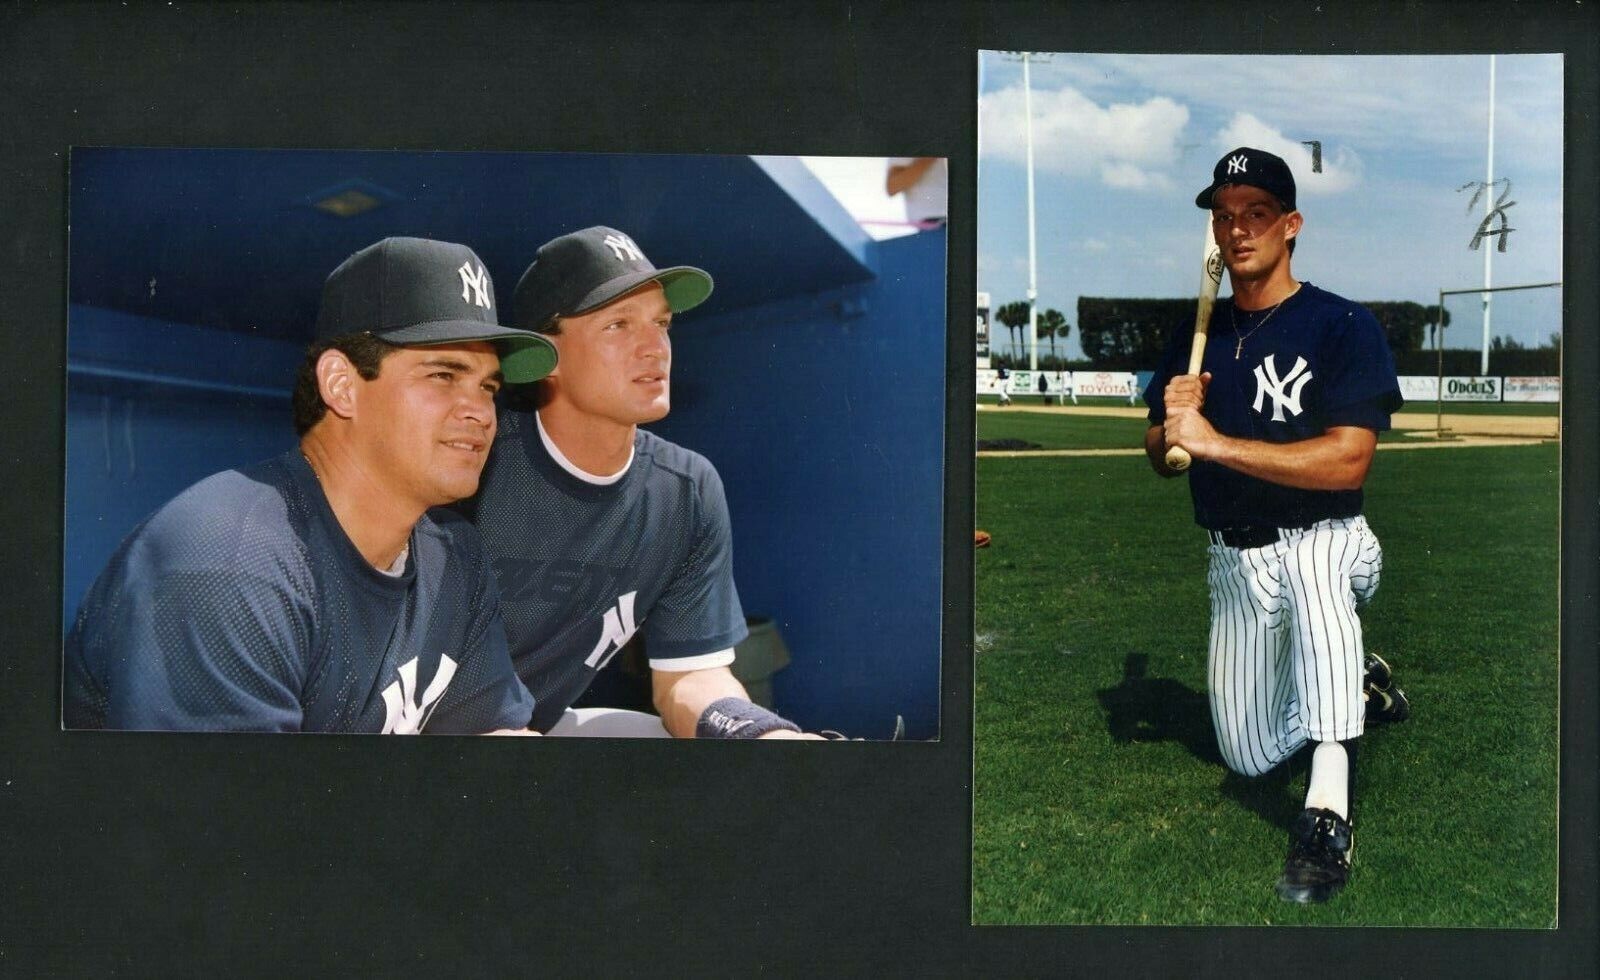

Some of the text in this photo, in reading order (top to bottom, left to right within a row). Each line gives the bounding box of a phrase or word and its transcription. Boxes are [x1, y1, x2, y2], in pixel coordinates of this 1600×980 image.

[1227, 154, 1249, 176] NY
[603, 234, 644, 262] NY
[457, 260, 491, 310] NY
[1080, 384, 1127, 394] TOYOTA
[1252, 353, 1313, 423] NY
[1448, 379, 1496, 394] O'DOUL'S
